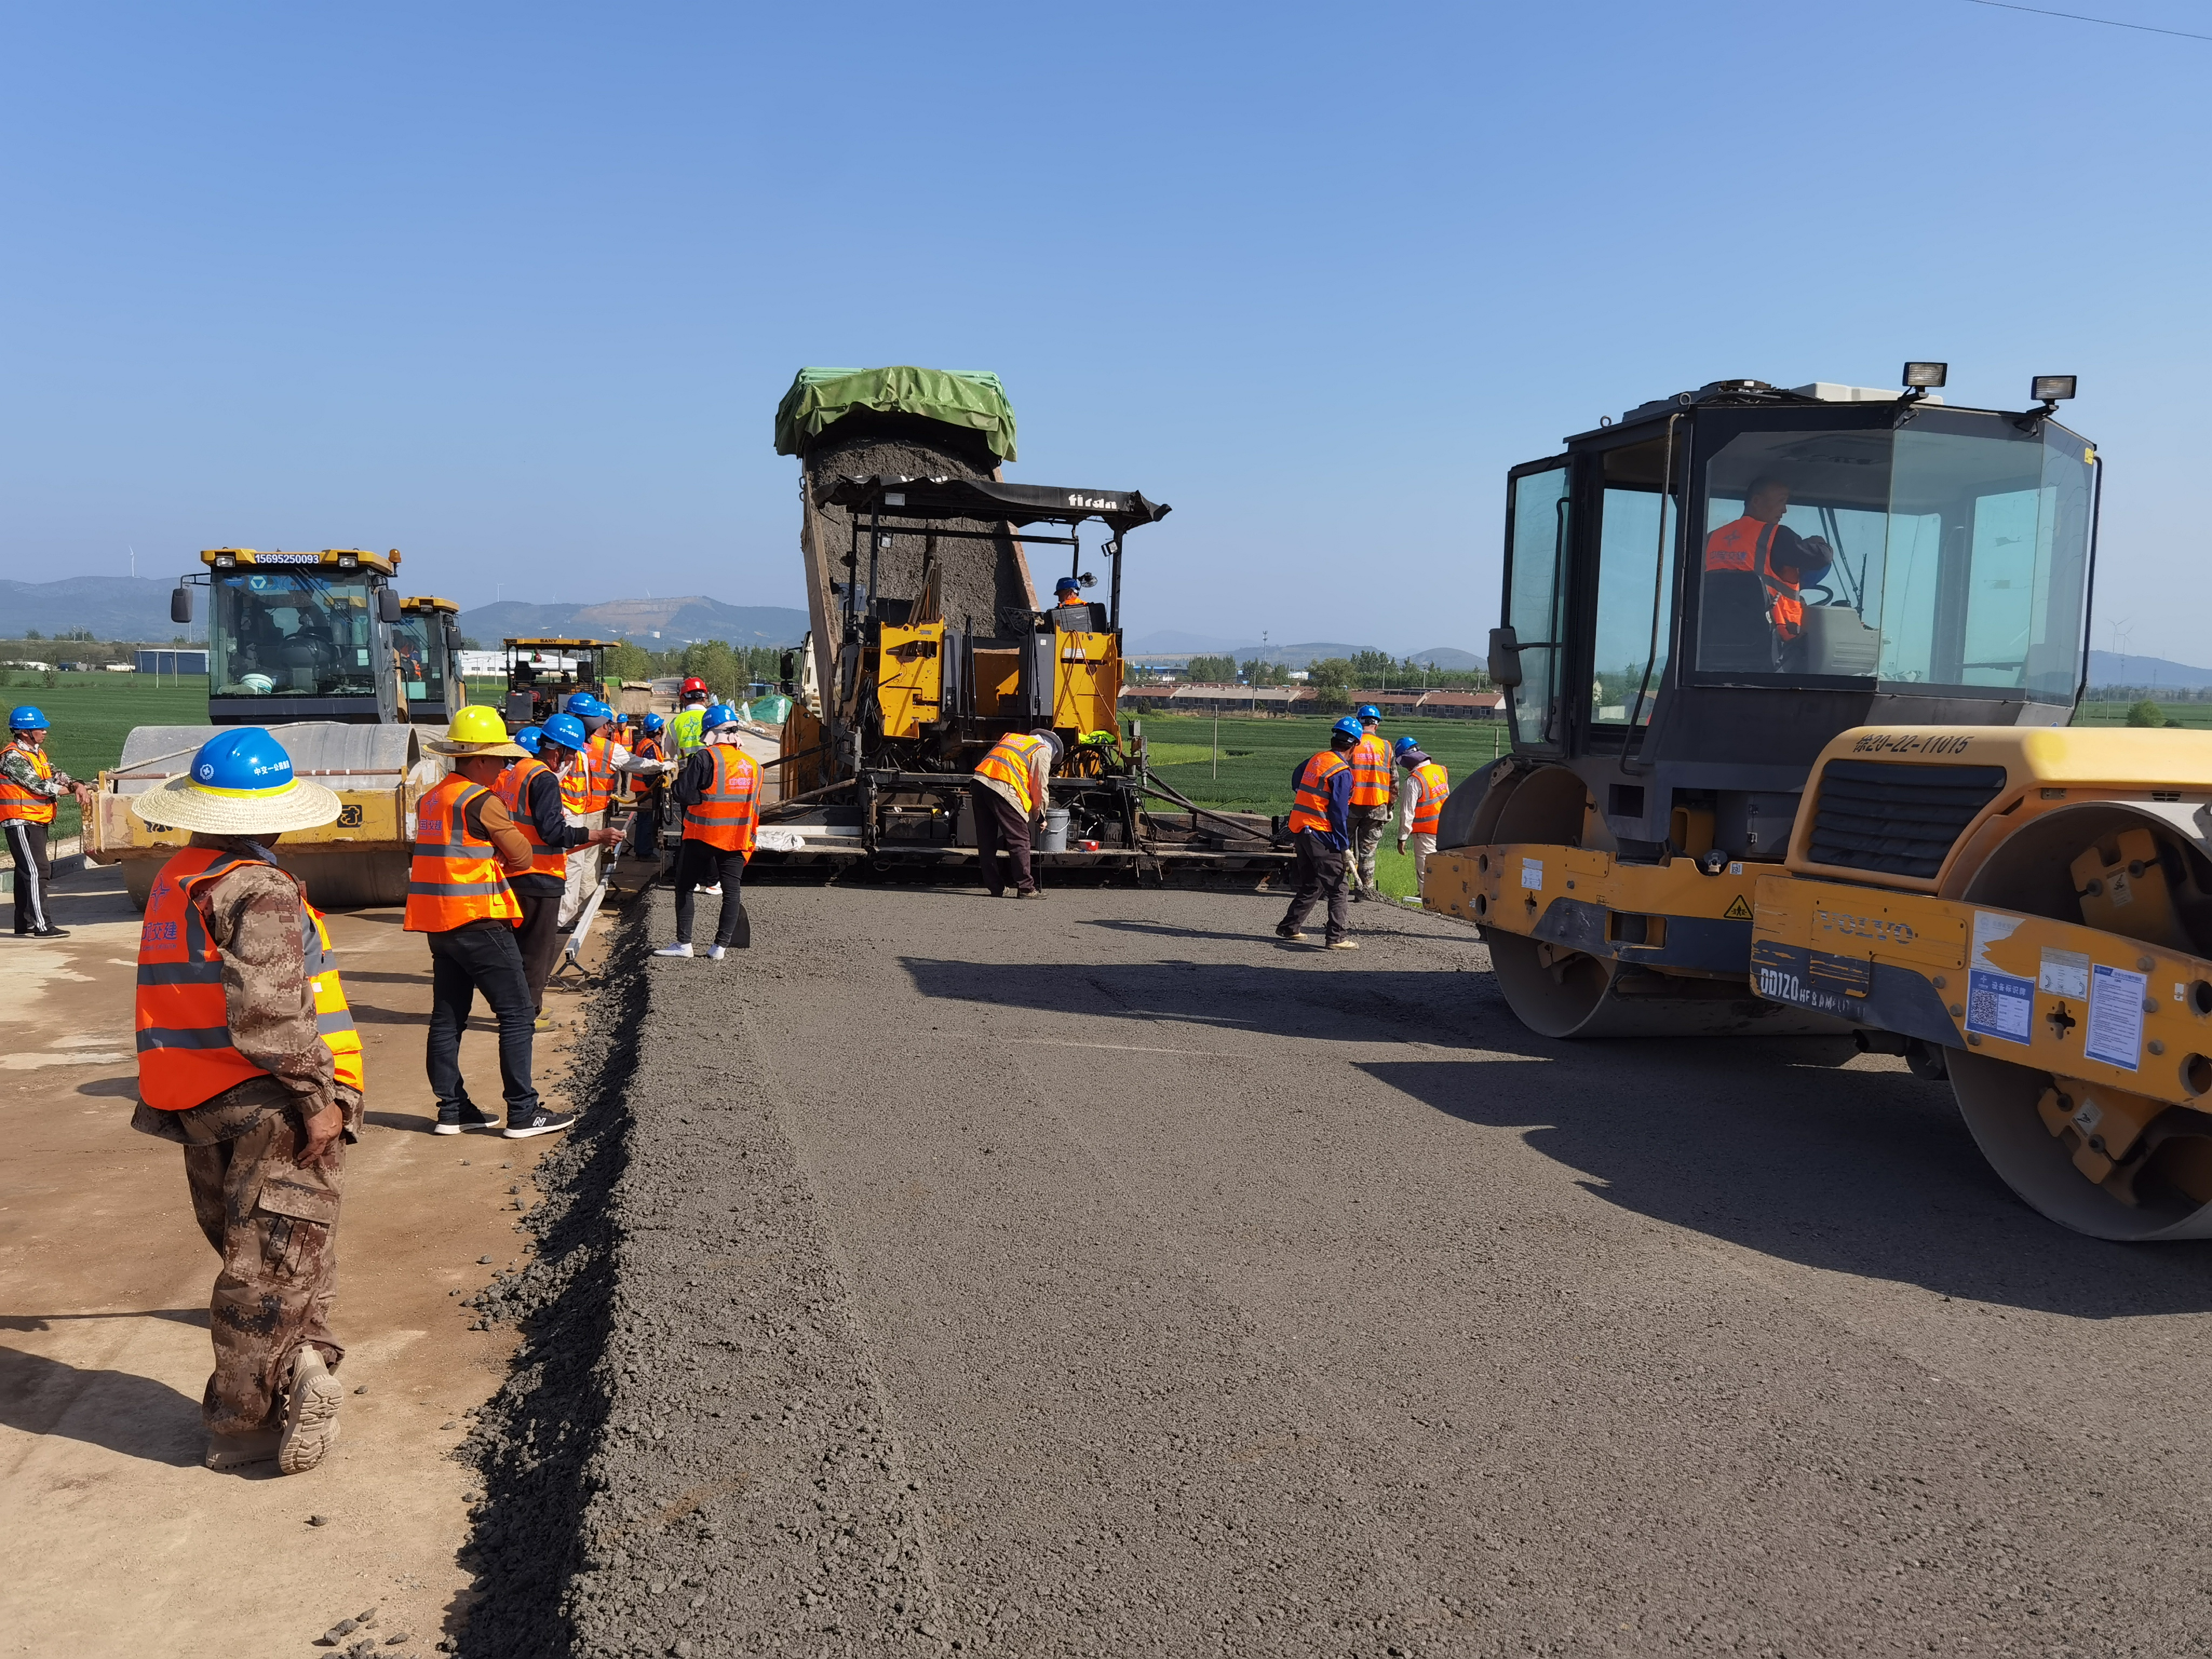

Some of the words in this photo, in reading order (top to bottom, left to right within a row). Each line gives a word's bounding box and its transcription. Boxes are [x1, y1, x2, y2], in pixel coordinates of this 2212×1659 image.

[255, 554, 320, 564] 15695250093
[1853, 734, 1975, 754] 徐20-22-11015
[1817, 909, 1913, 945] VOLVO
